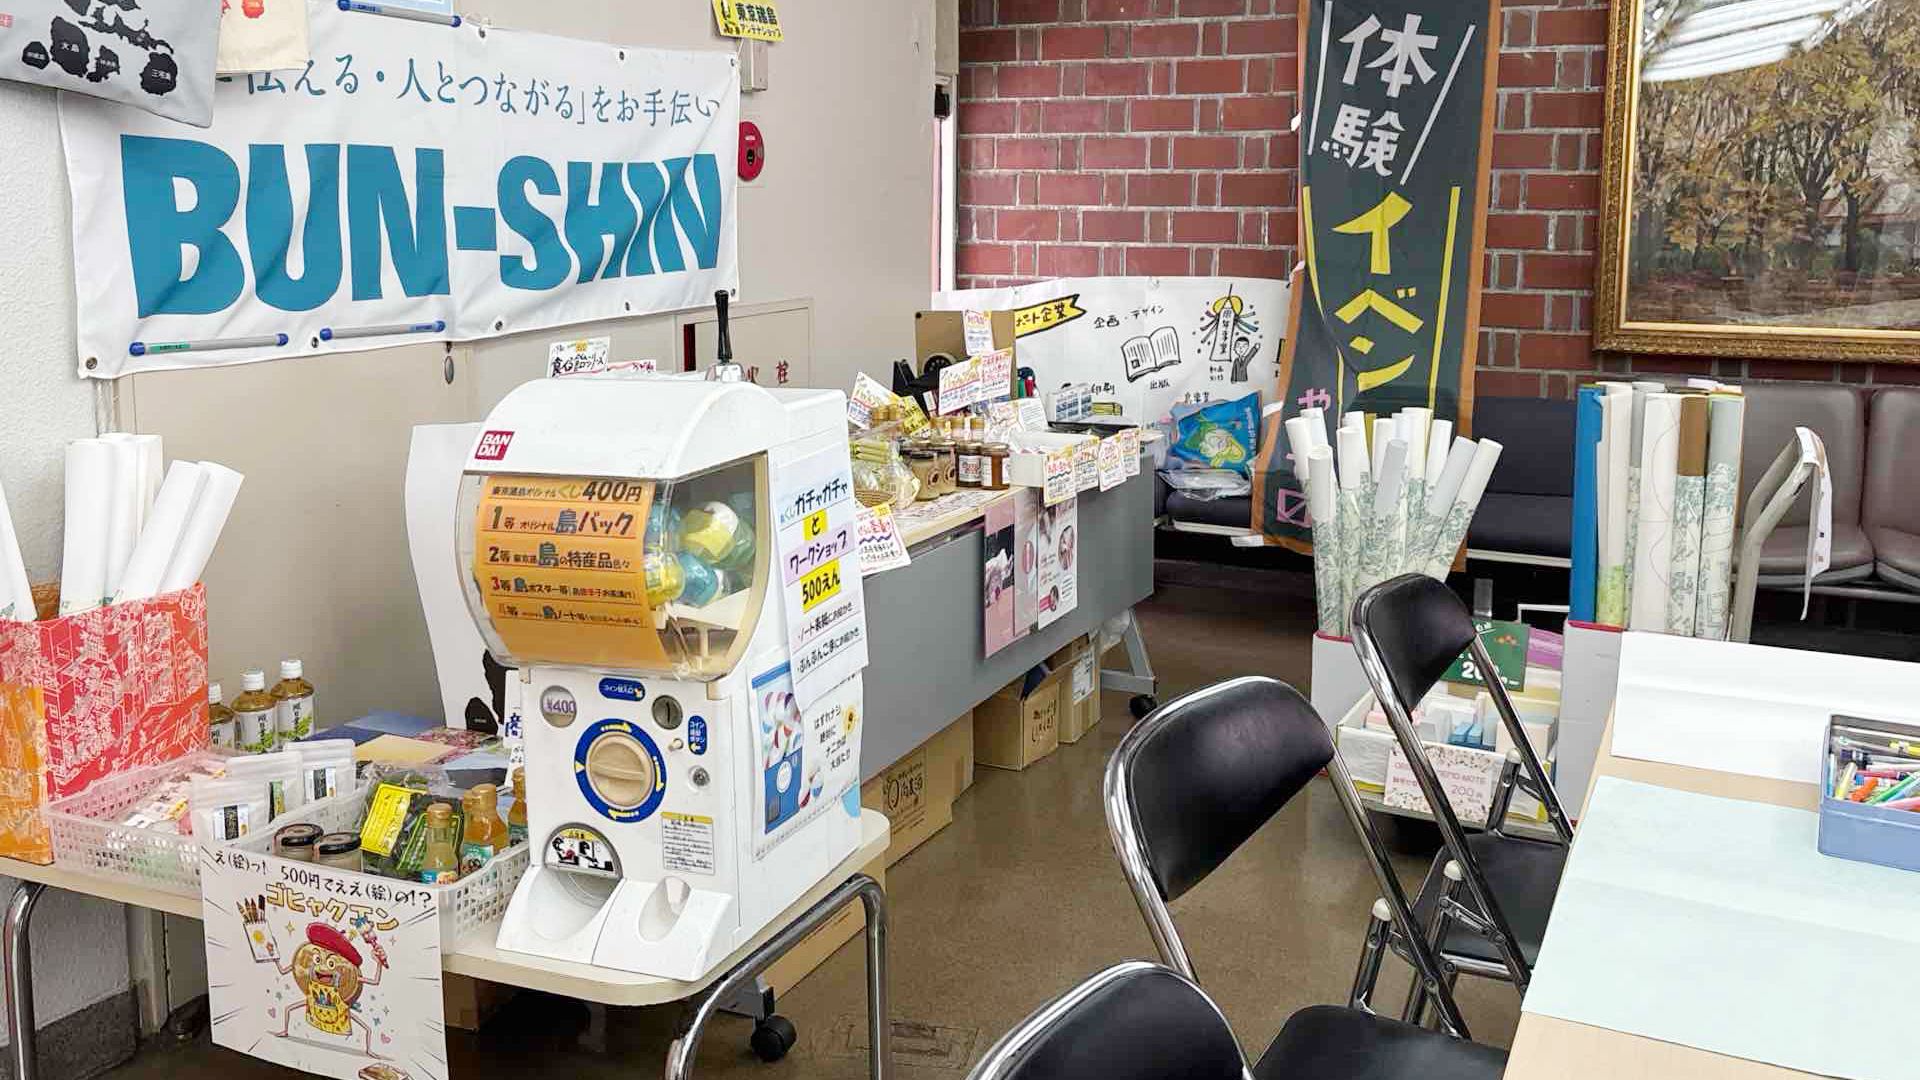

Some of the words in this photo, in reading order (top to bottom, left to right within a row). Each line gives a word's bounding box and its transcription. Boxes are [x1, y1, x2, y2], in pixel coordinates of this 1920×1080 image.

[1331, 13, 1439, 177] 体験
[120, 133, 722, 317] BUN-SHIN
[1094, 304, 1165, 329] 企画・デザイン
[1332, 190, 1424, 445] イベン
[477, 445, 500, 457] DAI
[483, 433, 511, 445] BAN
[811, 516, 821, 536] と
[790, 529, 848, 574] ワークショップ
[802, 568, 840, 605] 500えん
[266, 882, 400, 931] ゴヒャクエン
